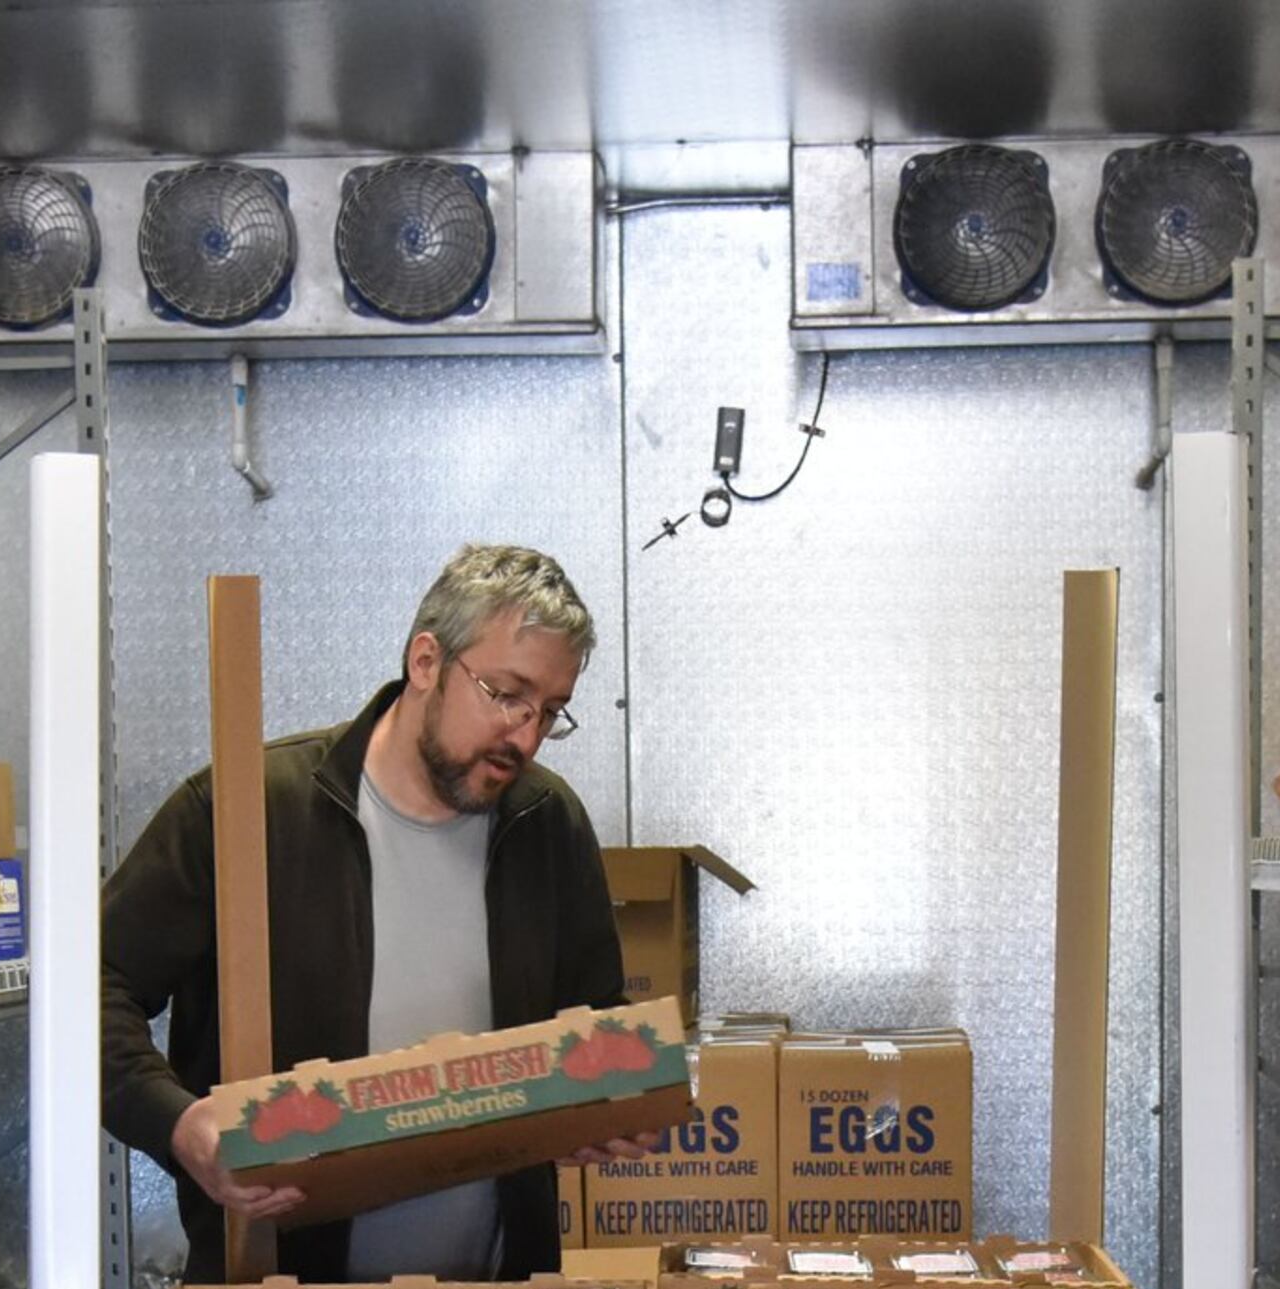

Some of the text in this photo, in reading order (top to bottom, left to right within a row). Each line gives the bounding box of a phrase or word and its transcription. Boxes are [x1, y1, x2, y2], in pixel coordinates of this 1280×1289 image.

[346, 1043, 550, 1112] FARM FRESH
[385, 1086, 528, 1133] strawberries
[820, 1090, 869, 1102] DOZEN
[810, 1105, 935, 1154] EGGS
[669, 1160, 758, 1176] WITH CARE
[793, 1161, 952, 1176] HANDLE WITH CARE
[595, 1199, 767, 1235] KEEP REFRIGERATED
[788, 1200, 961, 1233] KEEP REFRIGERATED
